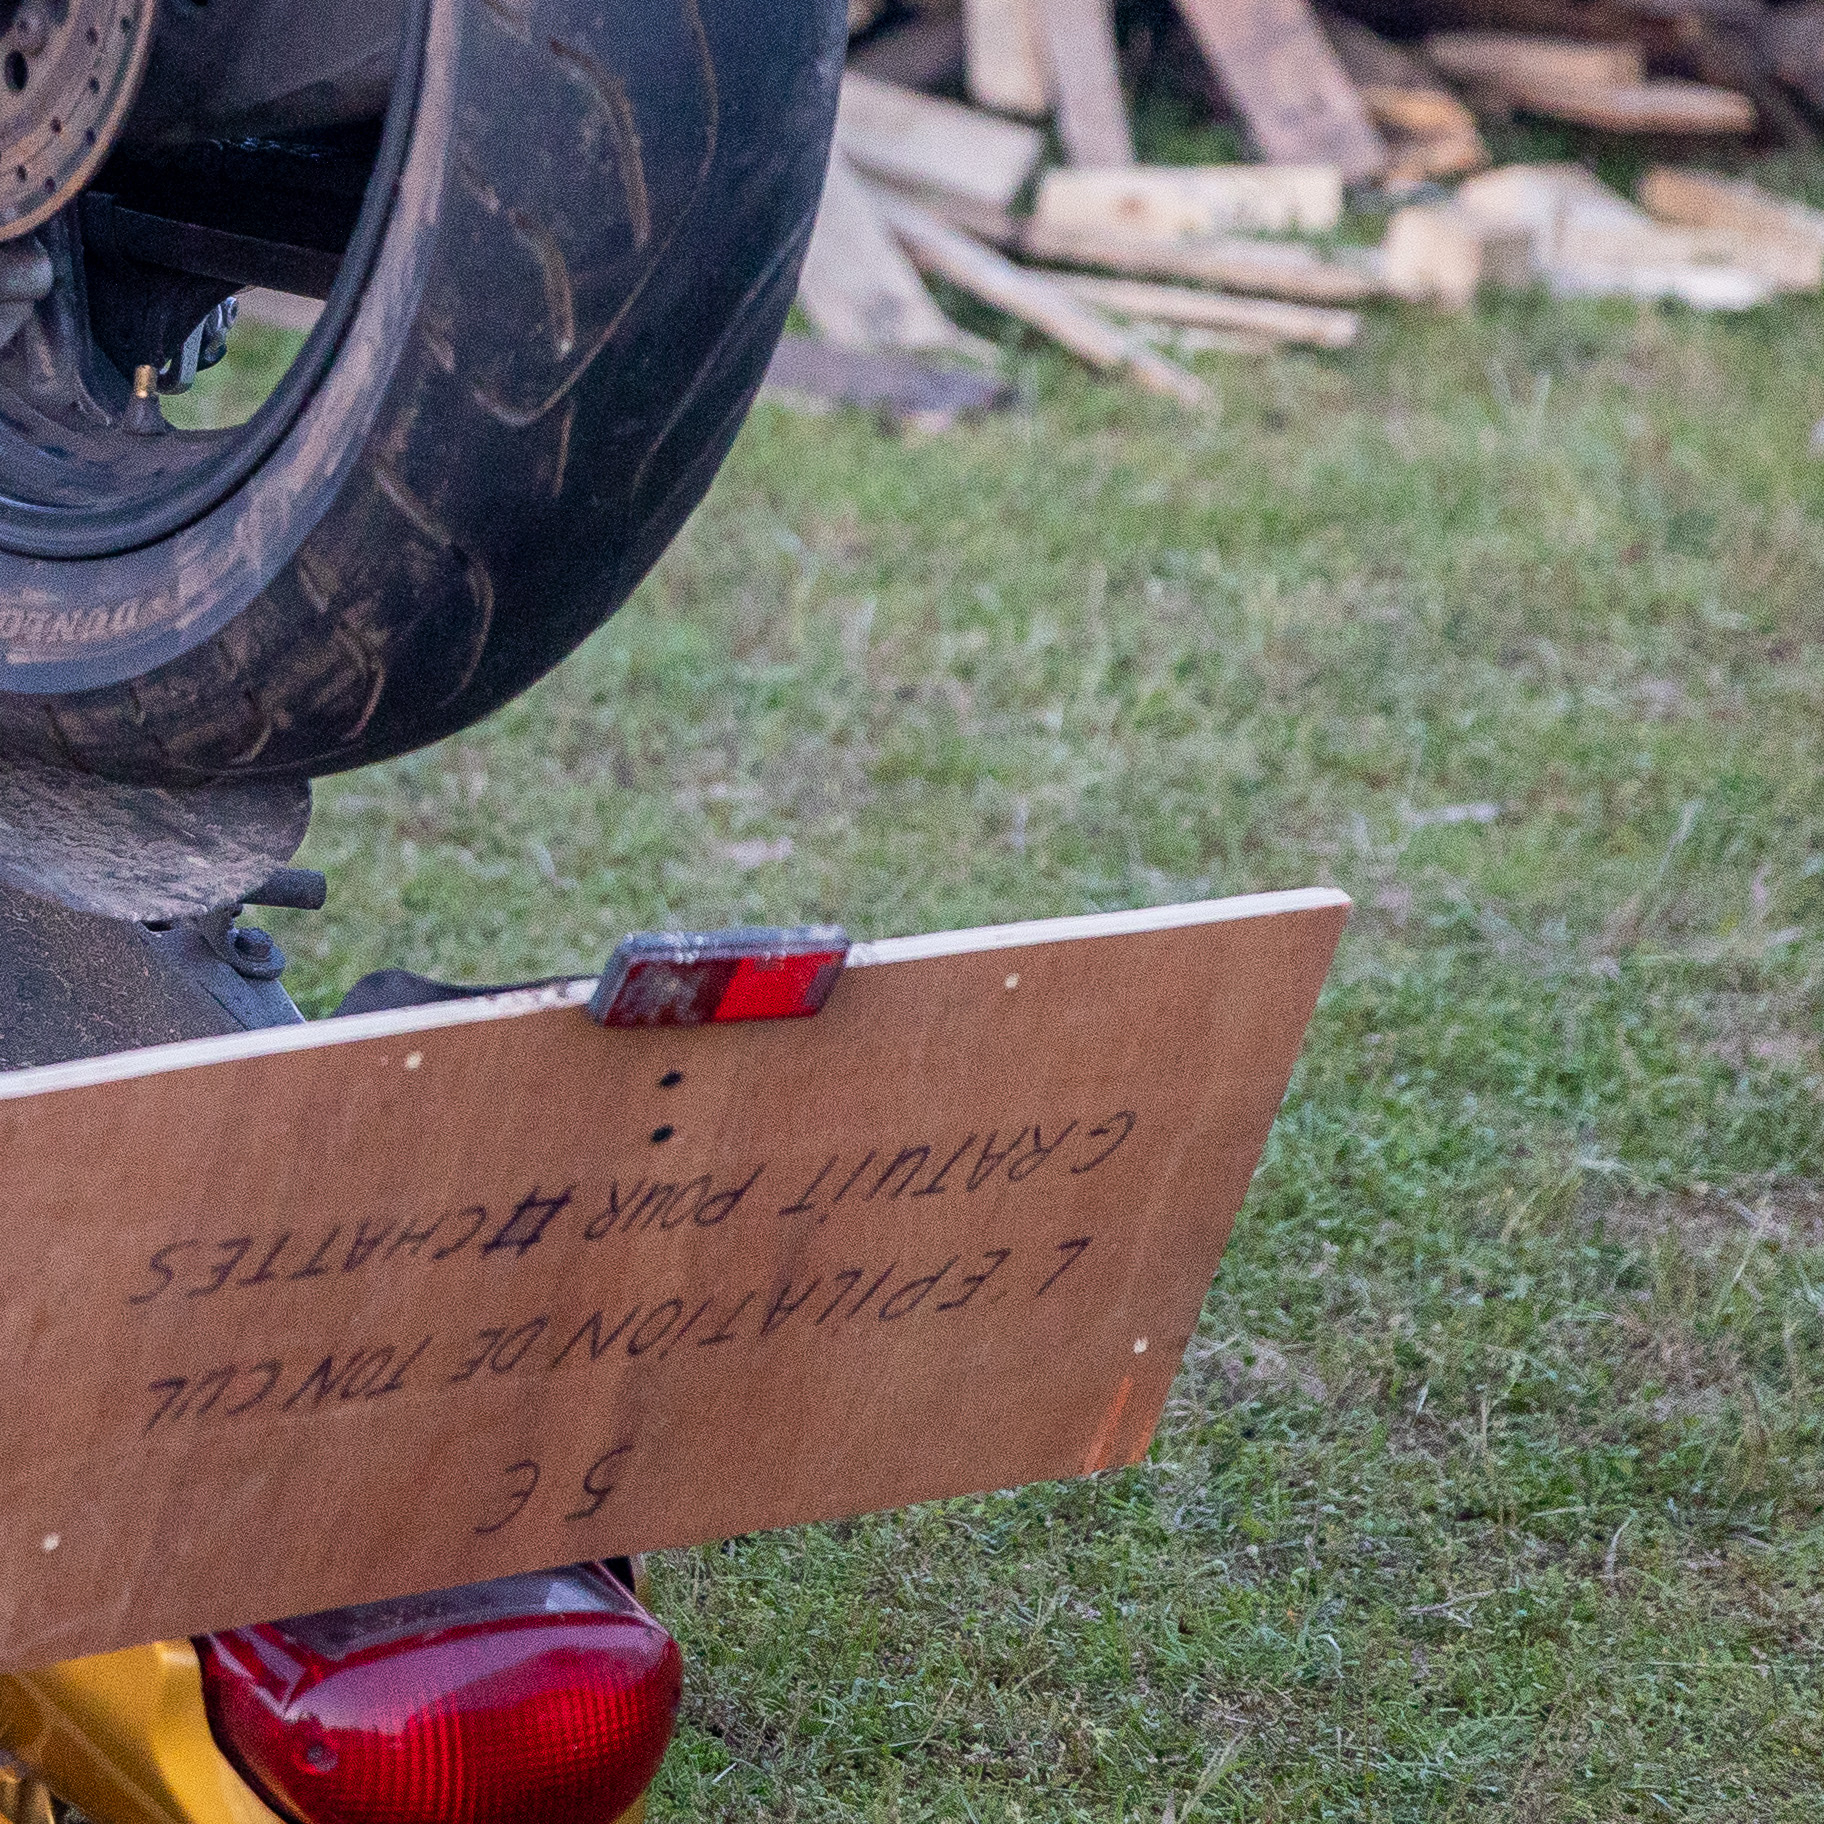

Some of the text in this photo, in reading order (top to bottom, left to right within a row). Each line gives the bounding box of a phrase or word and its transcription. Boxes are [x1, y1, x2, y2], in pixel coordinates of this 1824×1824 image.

[583, 1161, 764, 1241] POUR
[779, 1110, 1137, 1224] GRATUIT
[281, 1335, 433, 1412] TON
[448, 1314, 549, 1384] DE
[141, 1359, 282, 1440] CUL
[564, 1443, 633, 1522] 5
